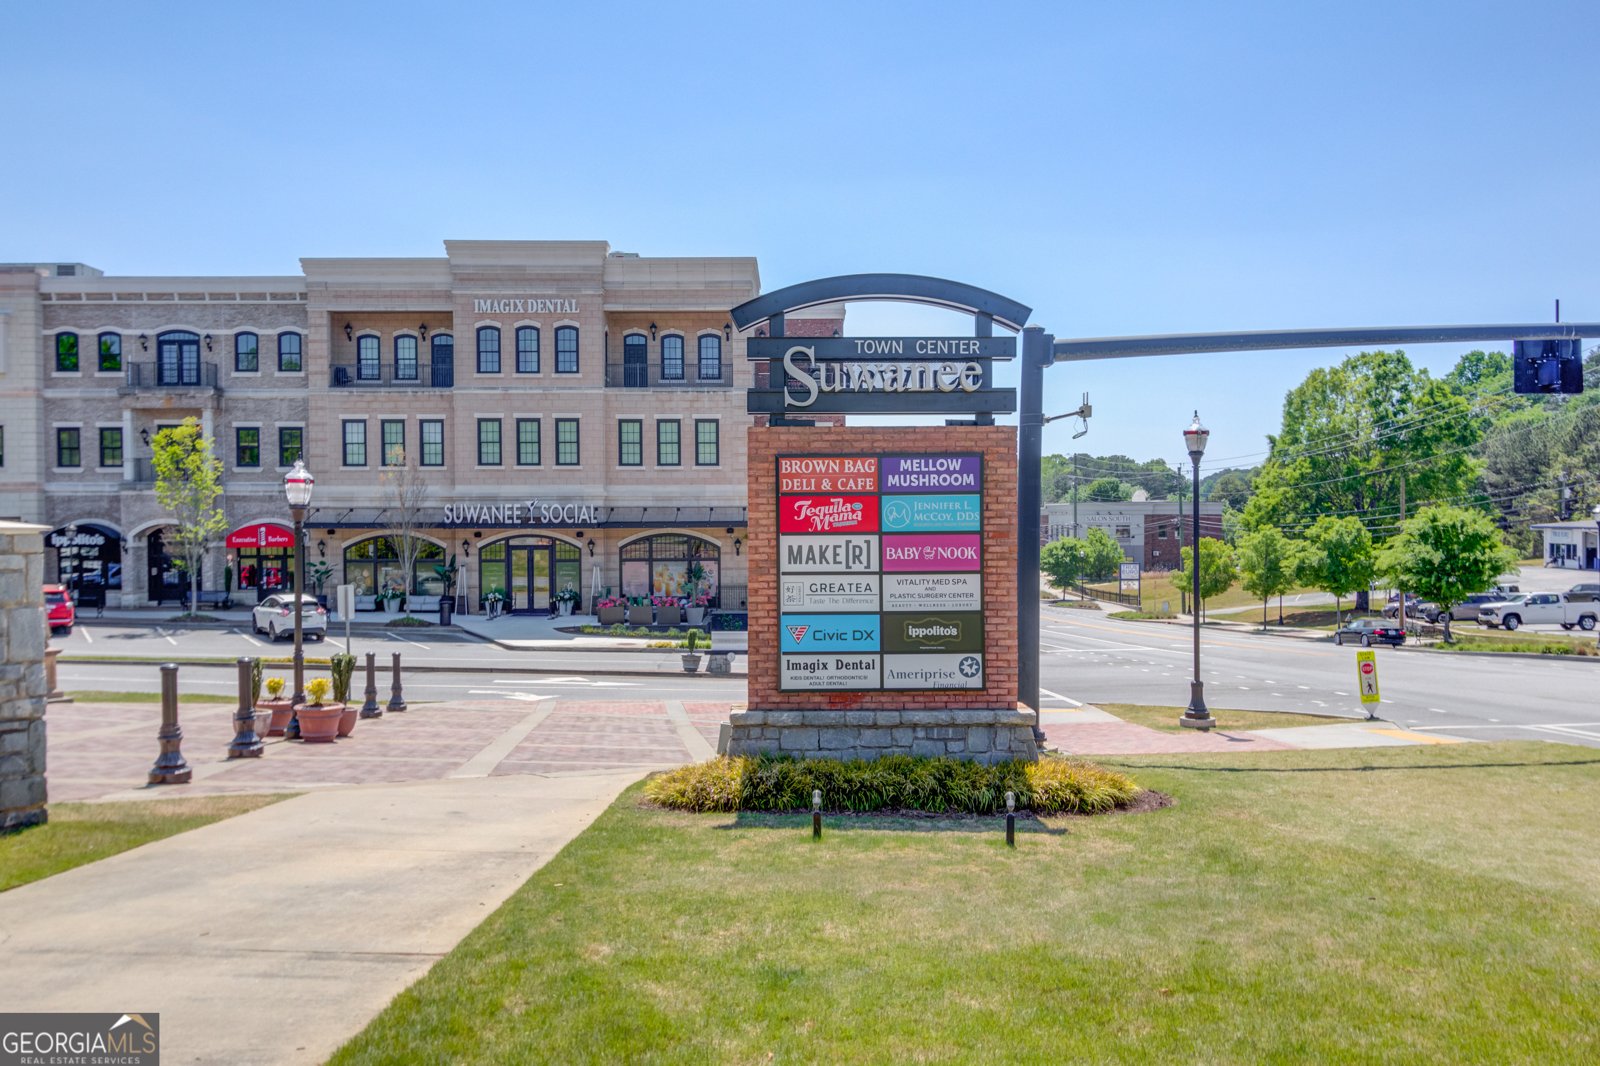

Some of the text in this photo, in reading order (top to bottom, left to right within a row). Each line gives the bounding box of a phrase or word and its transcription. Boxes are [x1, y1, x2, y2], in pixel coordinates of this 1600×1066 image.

[474, 298, 580, 314] IMAGIX DENTAL
[855, 340, 980, 354] TOWN CENTER
[783, 345, 983, 408] Suwanee
[781, 459, 875, 474] BROWN BAG
[900, 458, 961, 472] MELLOW
[782, 479, 874, 491] DELI & CAFE
[887, 473, 975, 487] MUSHROOM
[794, 497, 852, 520] Tequila
[913, 501, 961, 511] JENNIFER
[444, 503, 598, 524] SUWANEE SOCIAL
[808, 509, 863, 532] Mama
[957, 511, 980, 521] DDS
[787, 539, 871, 570] MAKE[R]
[886, 546, 977, 560] BABY NOOK
[809, 582, 873, 593] GREATEA
[896, 578, 931, 586] VITALITY
[932, 578, 950, 586] MED
[813, 629, 874, 641] Civic DX
[908, 625, 958, 637] ippolito's
[786, 658, 875, 673] Imagix Dental
[887, 669, 956, 682] Ameriprise
[932, 680, 967, 688] Financial
